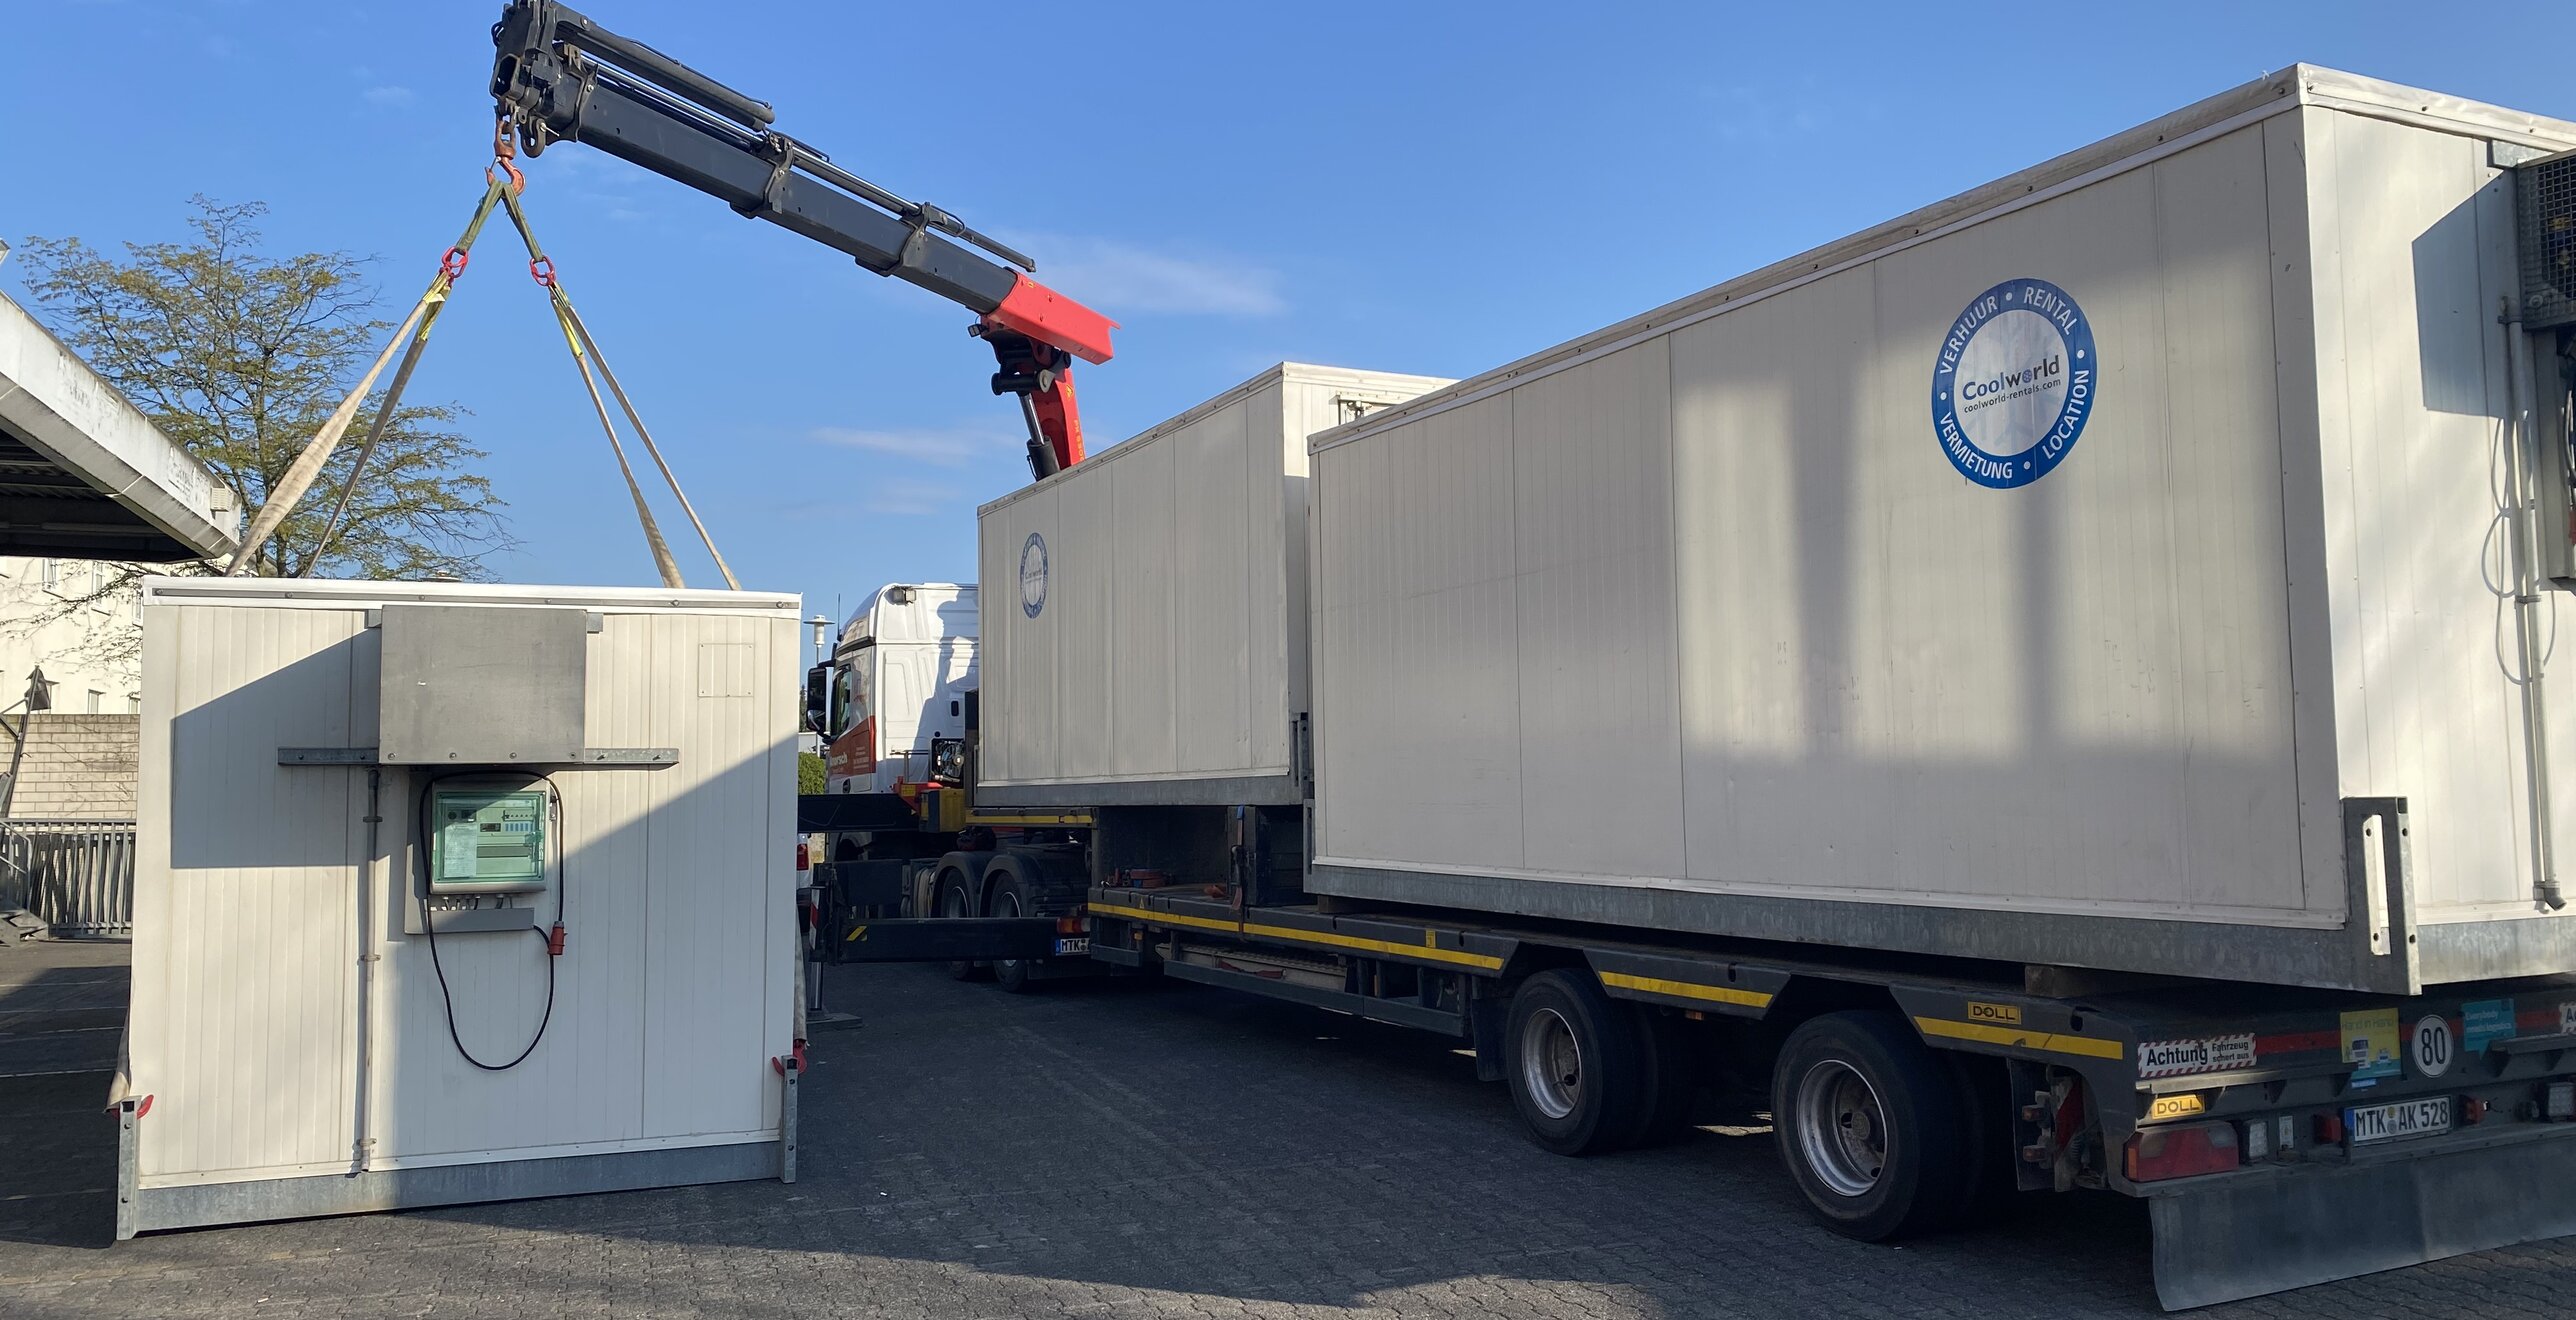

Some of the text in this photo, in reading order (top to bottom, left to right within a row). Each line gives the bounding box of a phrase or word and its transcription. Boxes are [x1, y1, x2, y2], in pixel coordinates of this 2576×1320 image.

[2024, 286, 2079, 335] RENTAL
[1940, 295, 1998, 374] VERHUUR
[1963, 355, 2060, 400] Coolworld
[1964, 379, 2062, 413] coolworld-rentals.com
[2041, 369, 2090, 459] LOCATION
[1940, 412, 2013, 479] VERMIETUNG
[1061, 940, 1080, 951] MTK
[1973, 1005, 2016, 1020] DOLL
[2147, 1046, 2208, 1066] Achtung
[2212, 1041, 2249, 1052] Fahrzeug
[2213, 1053, 2235, 1062] schert
[2421, 1027, 2446, 1066] 80
[2157, 1099, 2200, 1114] DOLL
[2356, 1101, 2448, 1136] MTK AK 528
